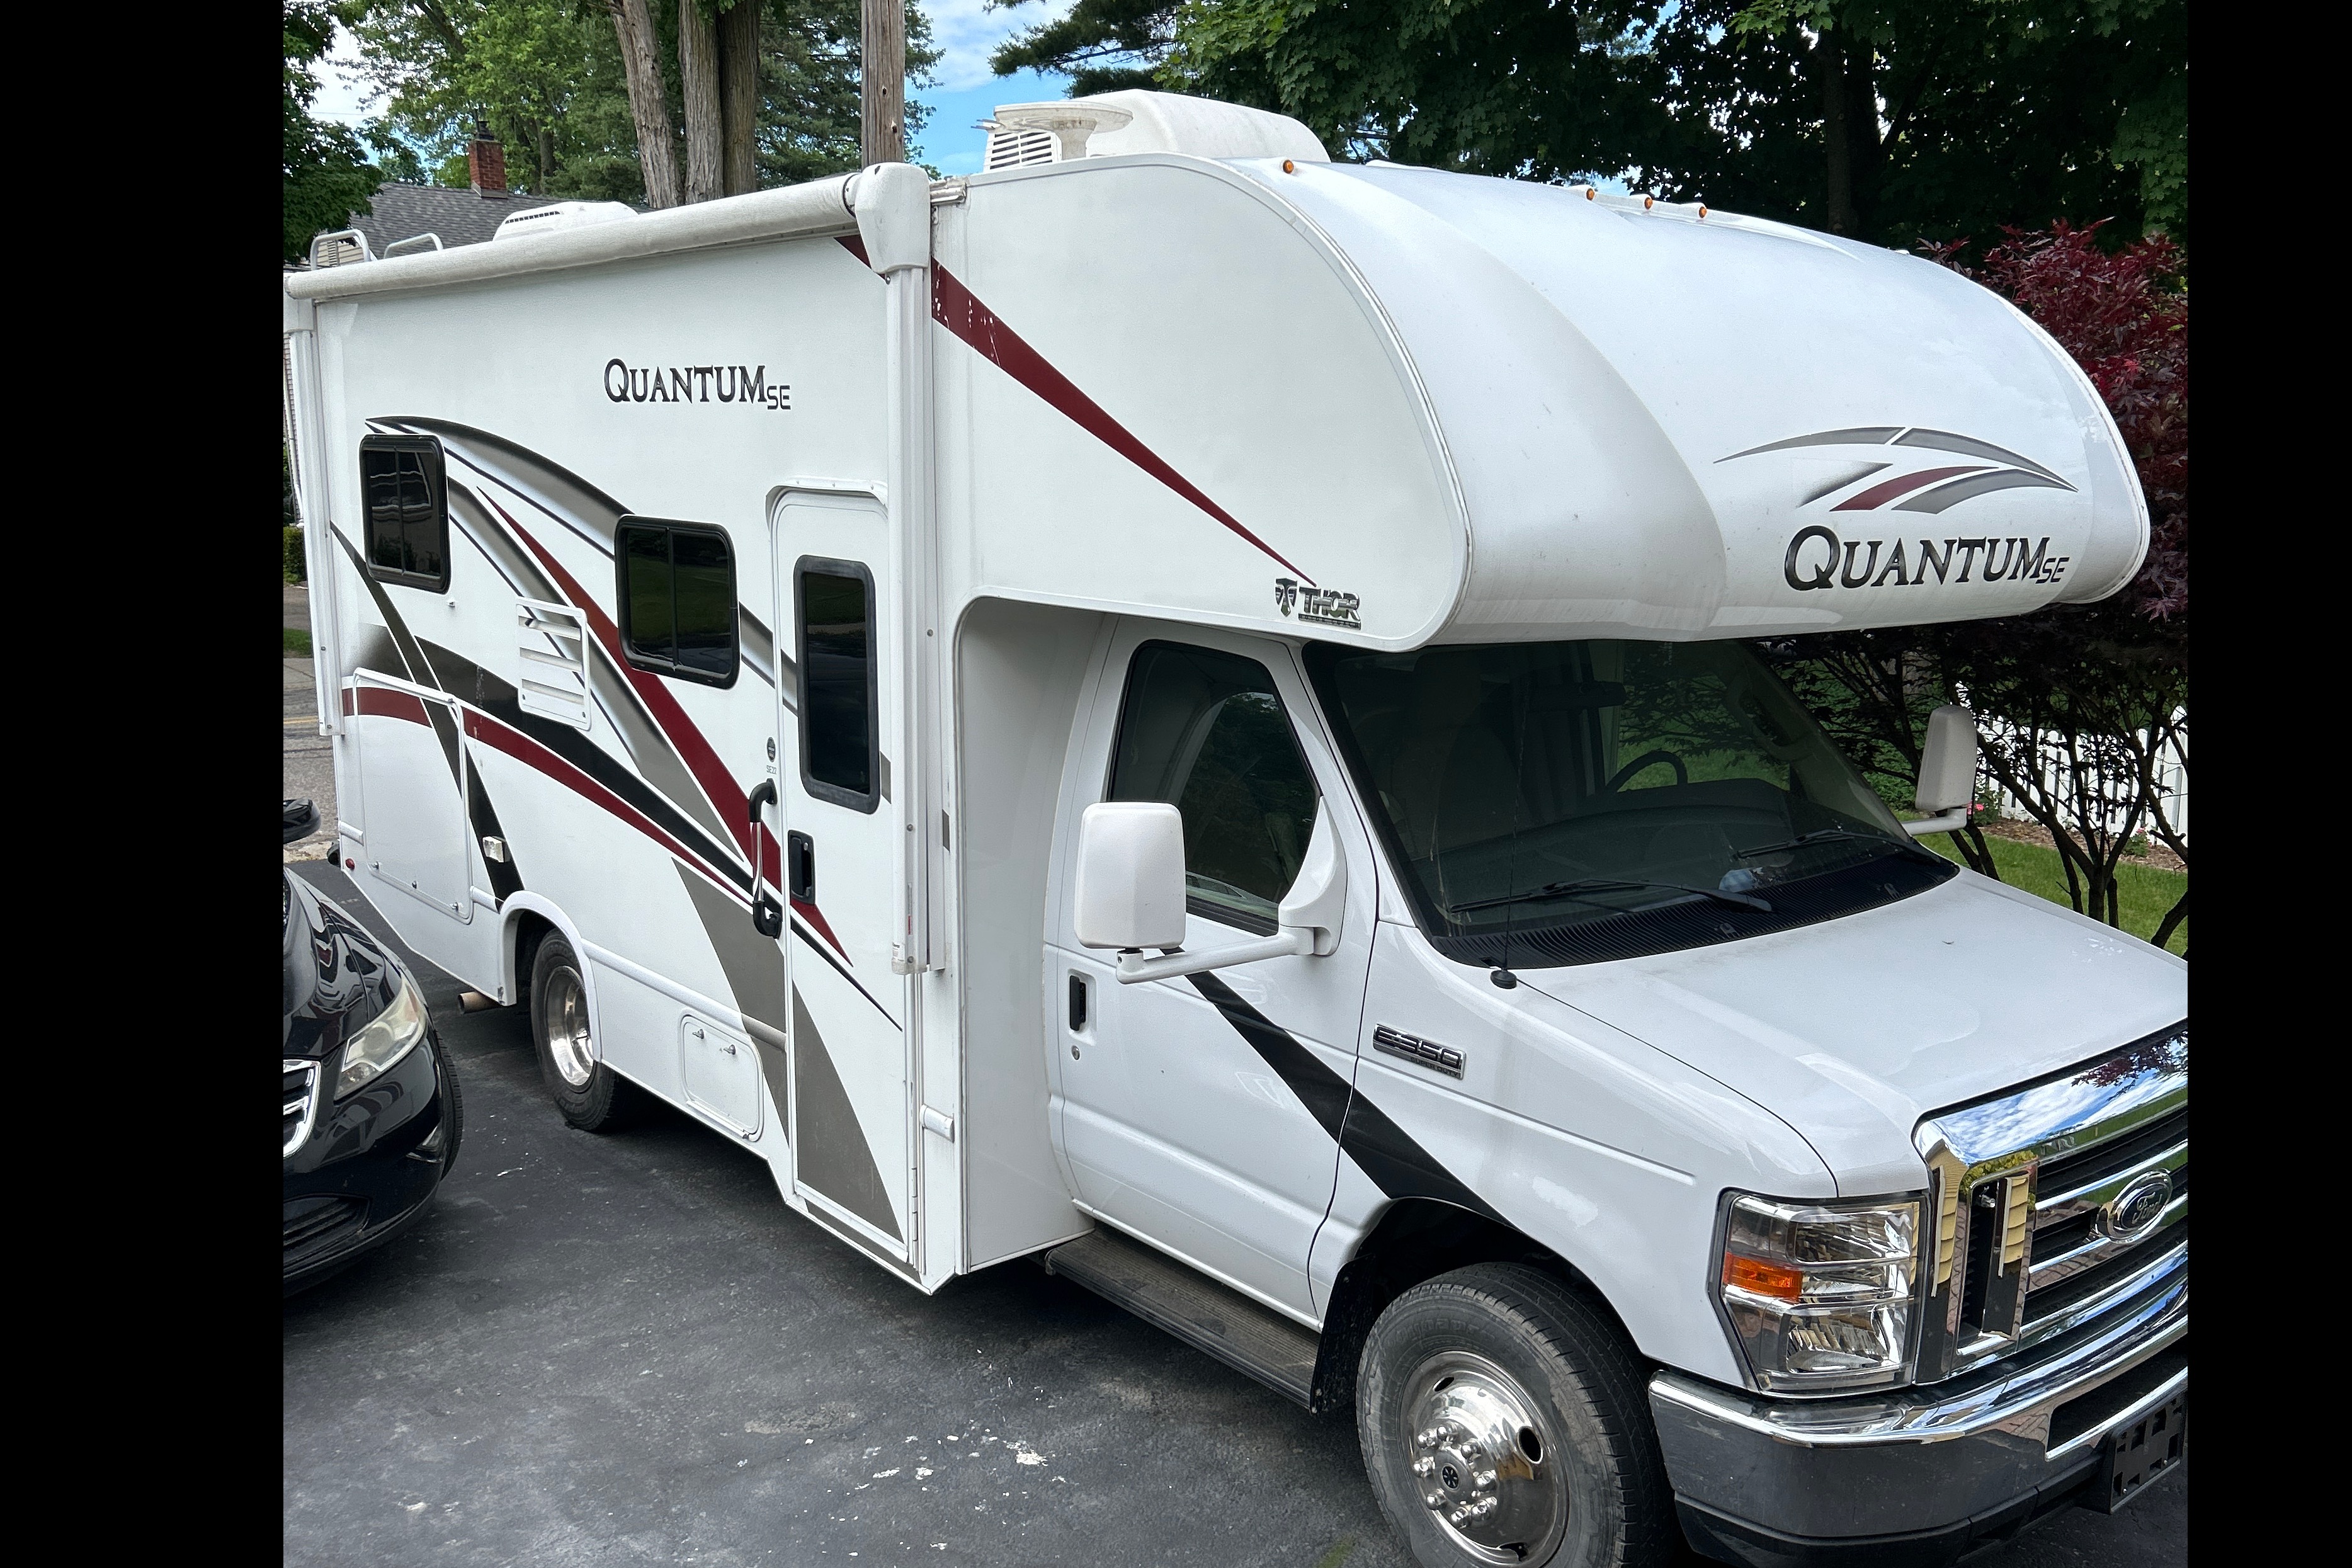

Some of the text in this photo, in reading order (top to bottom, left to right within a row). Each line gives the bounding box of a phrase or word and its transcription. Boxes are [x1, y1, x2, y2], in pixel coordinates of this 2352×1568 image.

[604, 358, 791, 410] QUANTUM SE
[1784, 525, 2070, 591] QUANTUM SE
[1298, 586, 1361, 622] THOR
[2131, 1191, 2163, 1225] Ford
